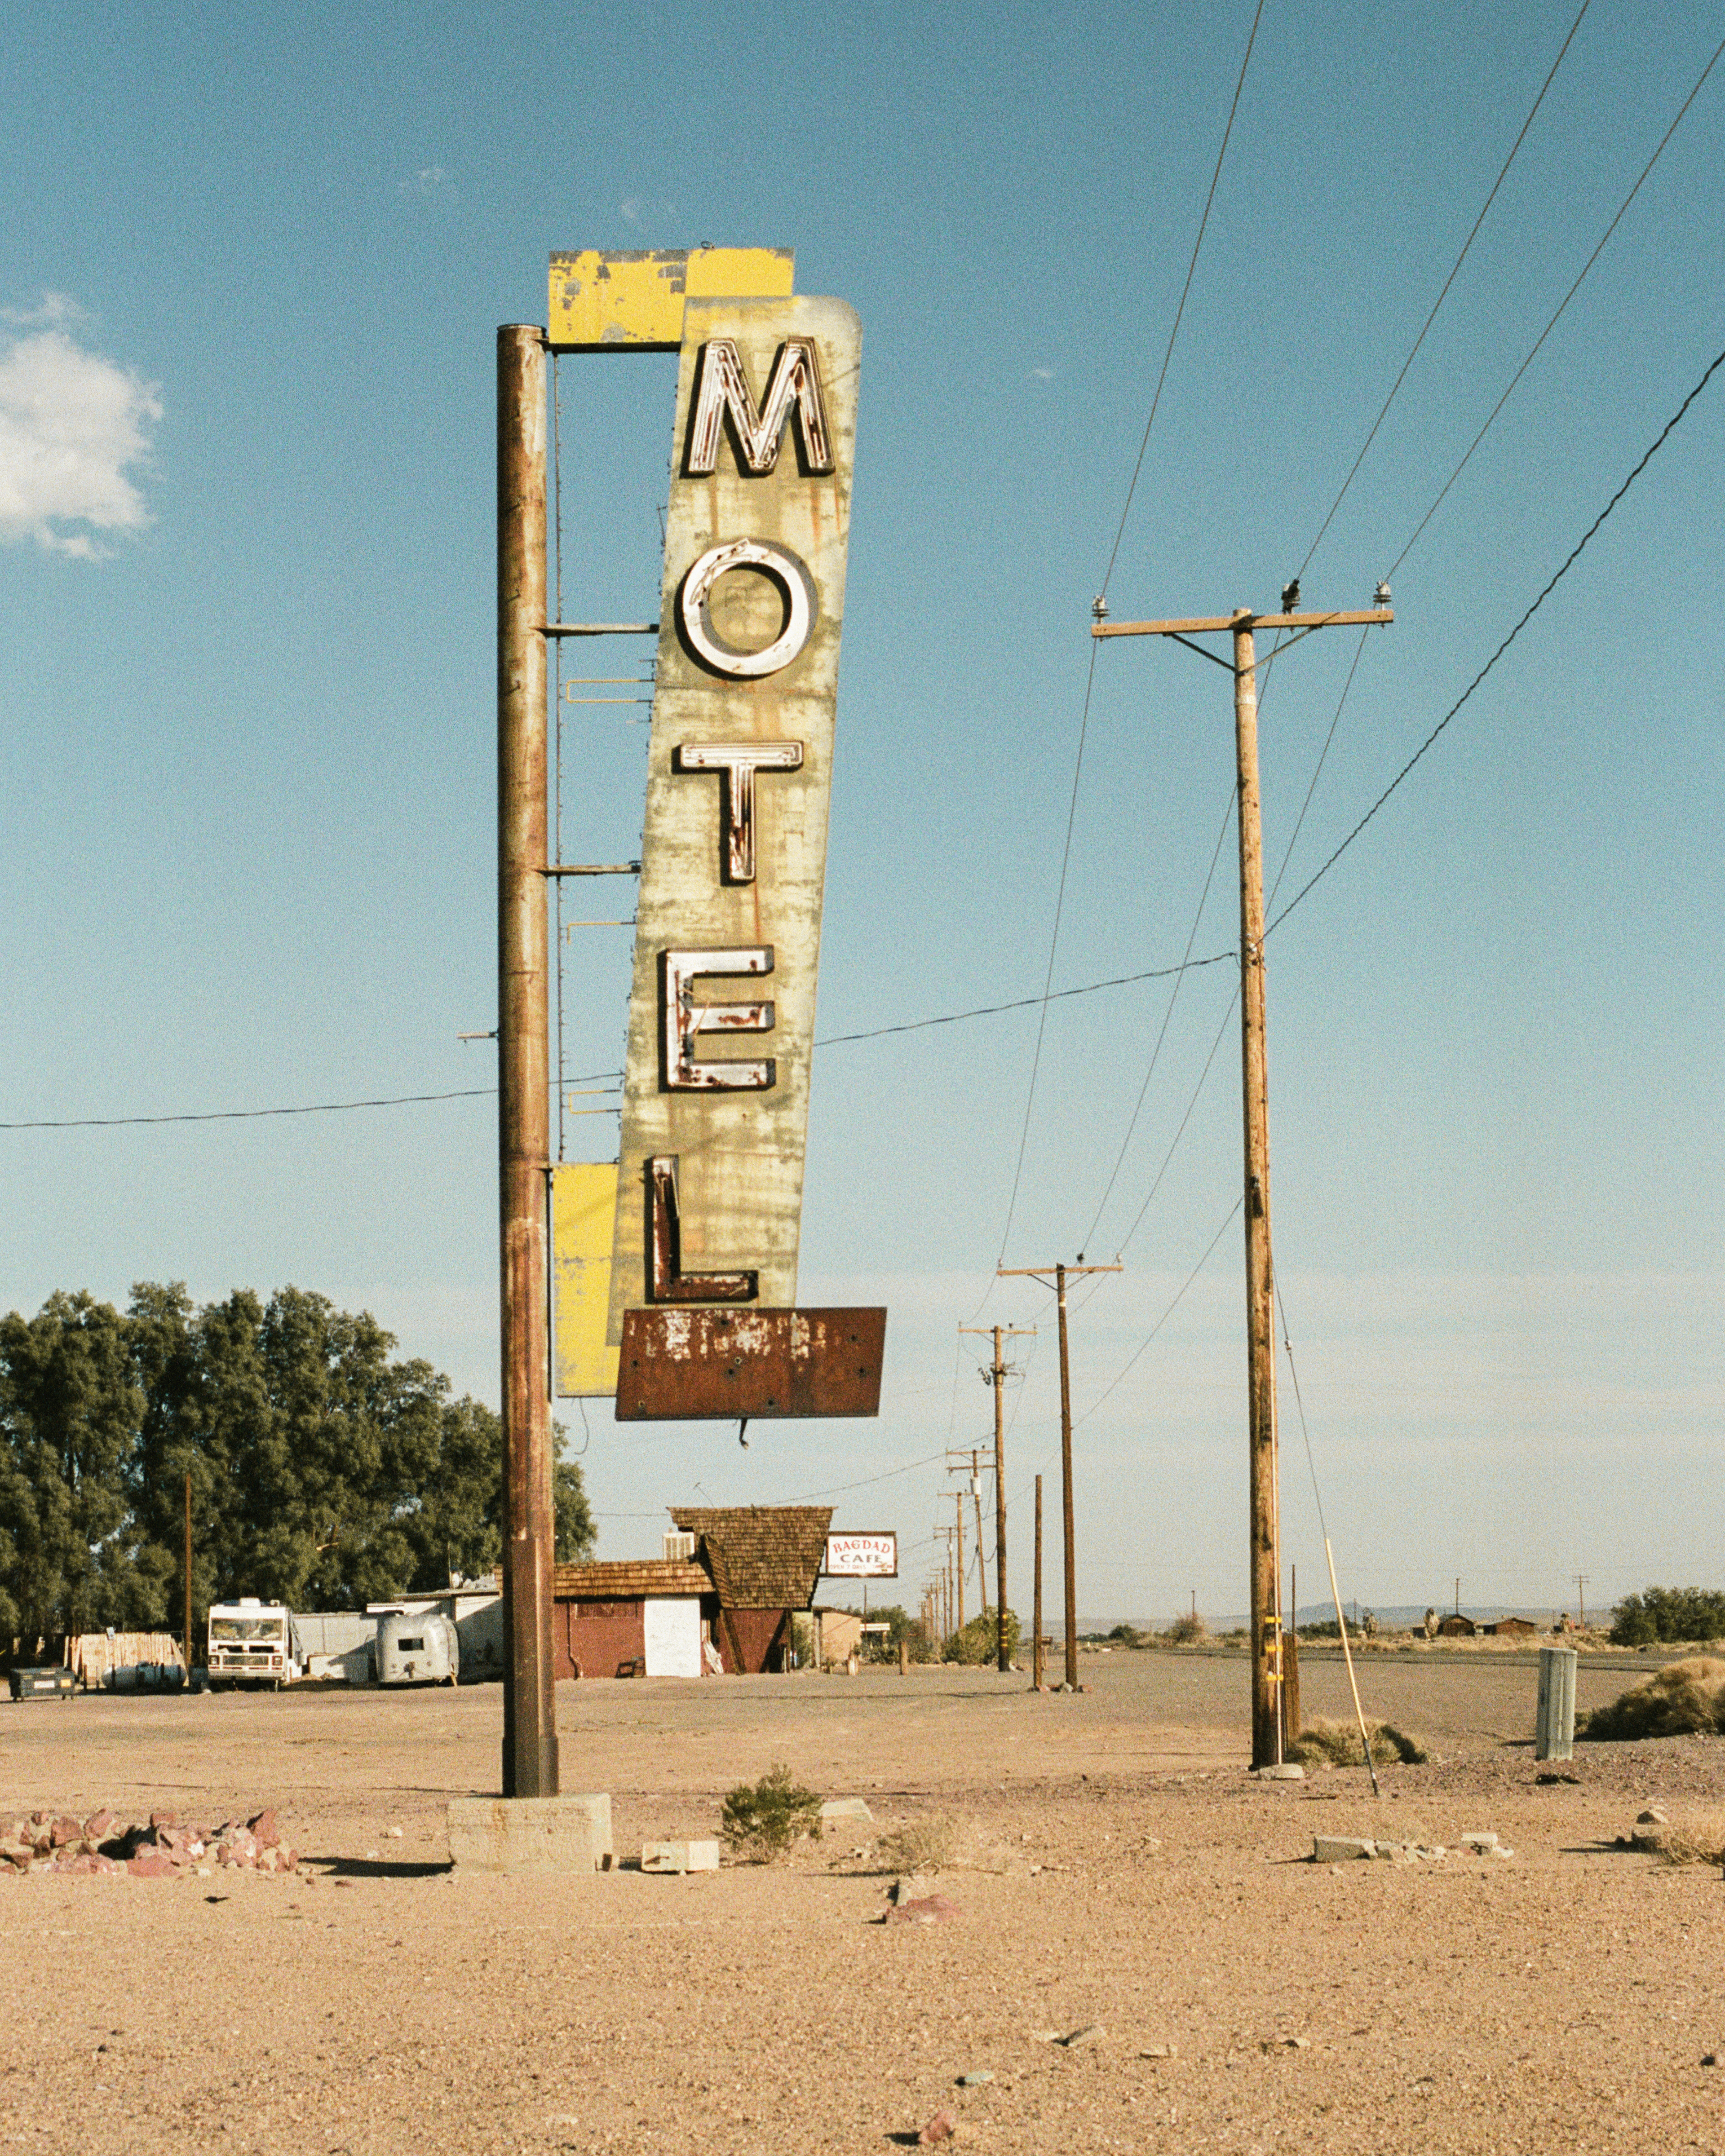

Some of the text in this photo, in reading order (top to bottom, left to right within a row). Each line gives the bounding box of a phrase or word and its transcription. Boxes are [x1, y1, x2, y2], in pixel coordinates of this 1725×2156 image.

[649, 336, 836, 1303] MOTEL
[832, 1540, 890, 1553] BAGDAD
[840, 1555, 882, 1563] CAFE
